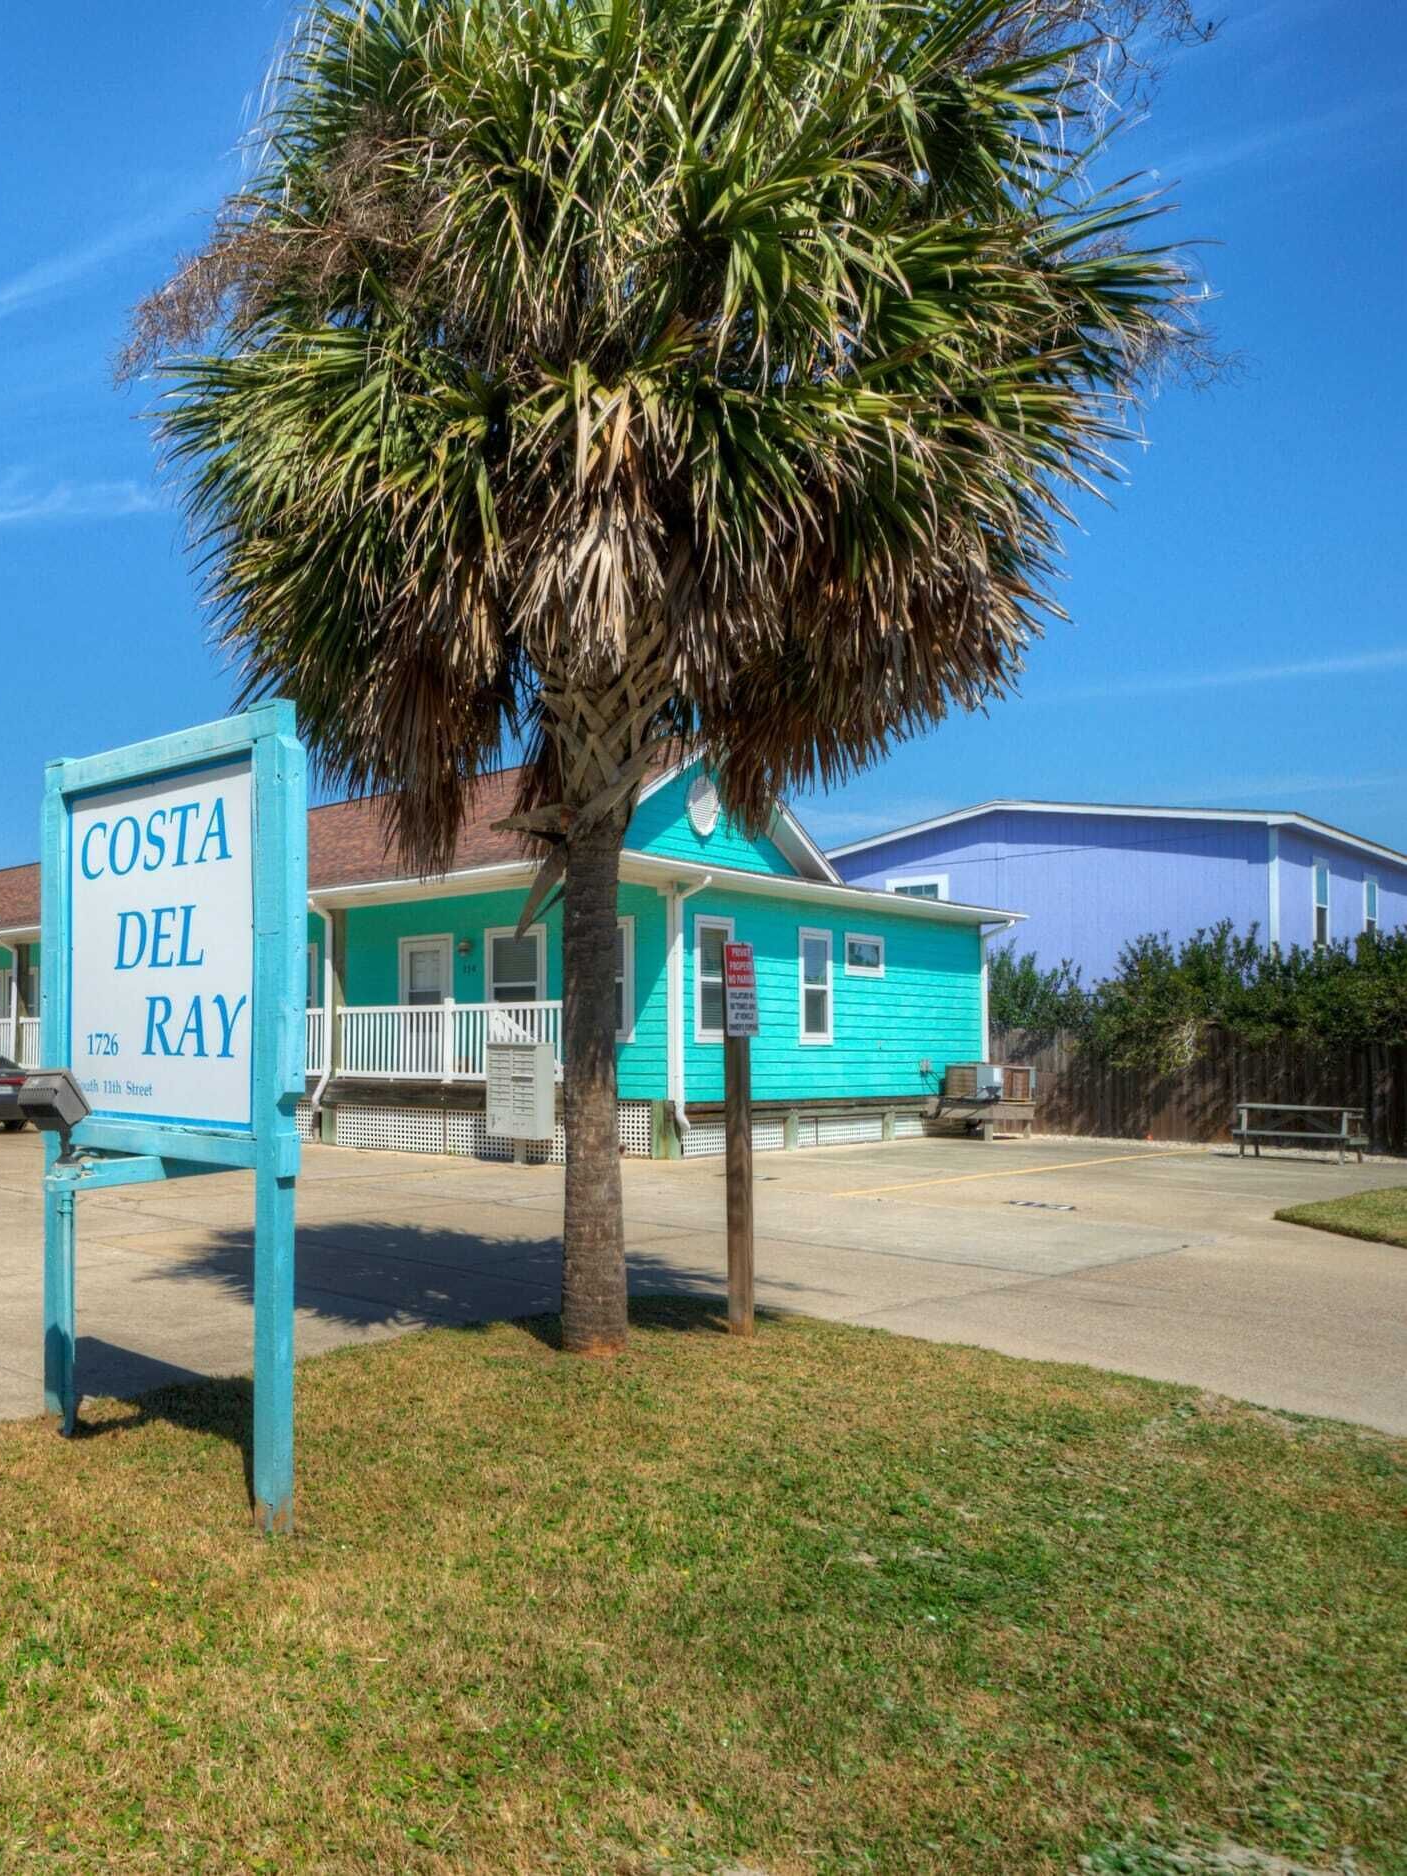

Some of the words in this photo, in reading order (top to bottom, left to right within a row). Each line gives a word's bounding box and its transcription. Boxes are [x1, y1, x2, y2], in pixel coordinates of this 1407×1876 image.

[81, 797, 232, 880] COSTA
[114, 904, 204, 970] DEL
[87, 1033, 119, 1056] 1726
[142, 994, 247, 1058] RAY
[77, 1079, 98, 1092] outh
[104, 1080, 122, 1094] 11th
[126, 1080, 153, 1096] Street
